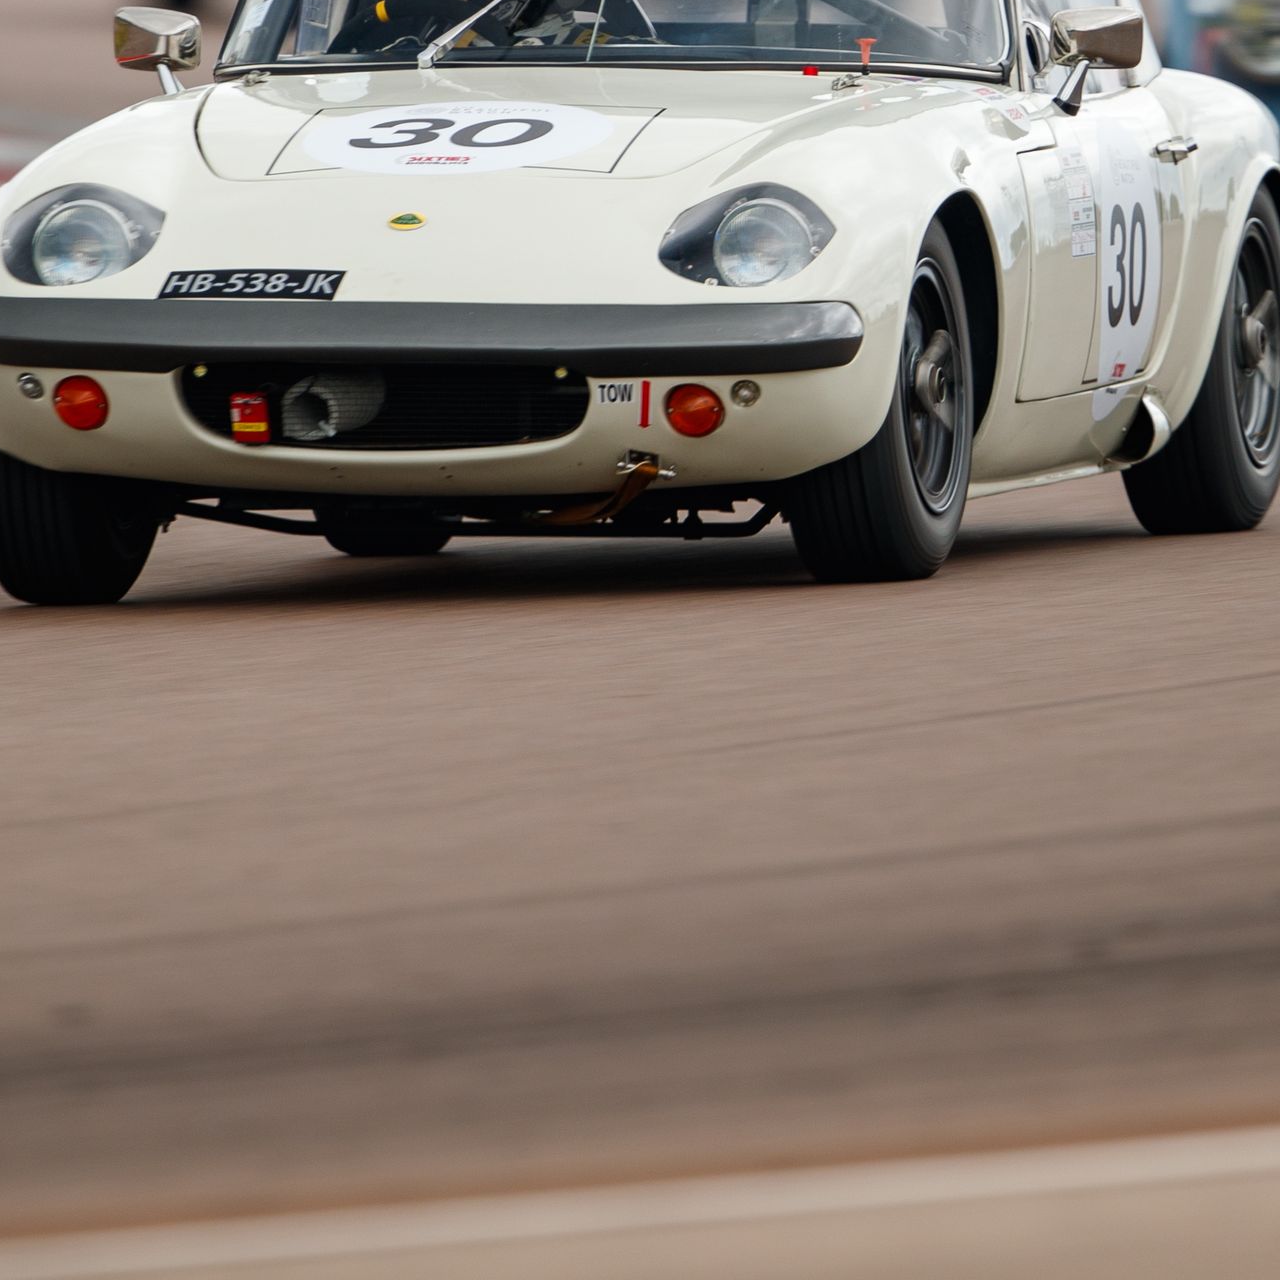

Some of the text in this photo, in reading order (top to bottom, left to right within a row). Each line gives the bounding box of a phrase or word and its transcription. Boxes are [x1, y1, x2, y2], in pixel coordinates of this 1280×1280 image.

[349, 118, 554, 149] 30
[1108, 202, 1147, 328] 30
[163, 273, 340, 294] HB-538-JK
[598, 383, 634, 402] TOW
